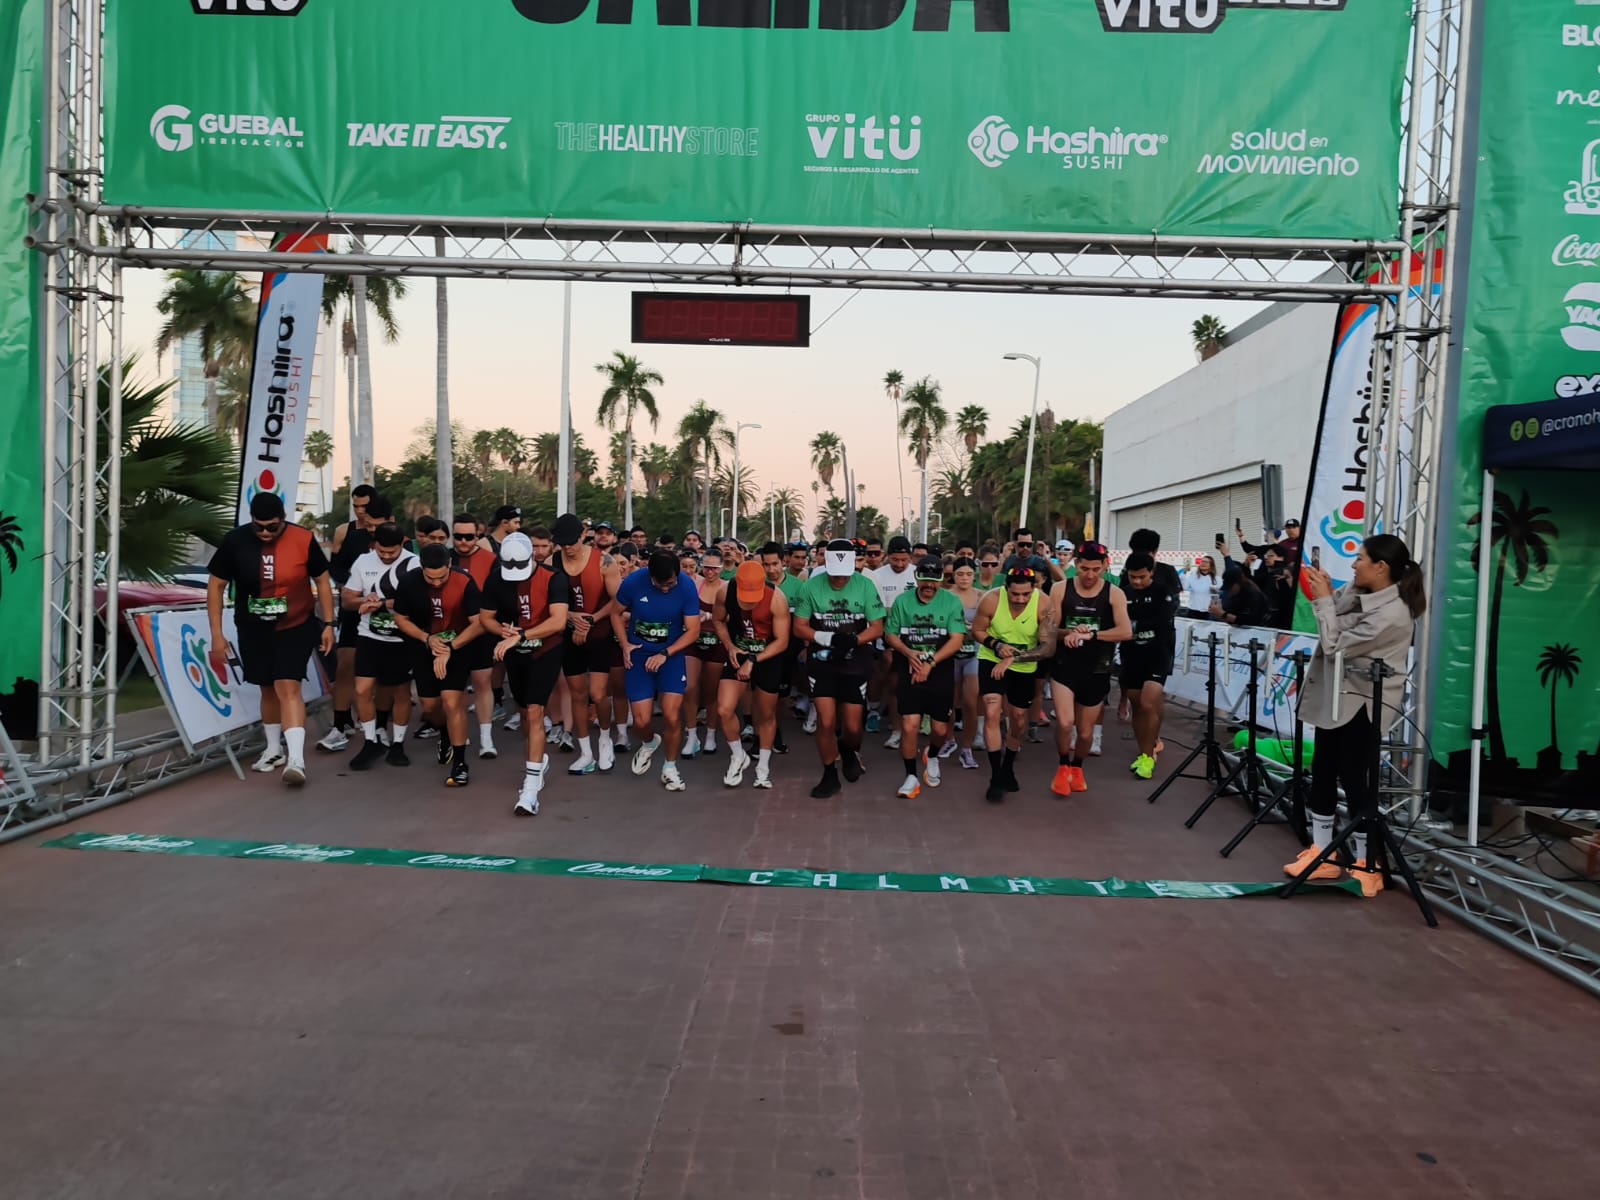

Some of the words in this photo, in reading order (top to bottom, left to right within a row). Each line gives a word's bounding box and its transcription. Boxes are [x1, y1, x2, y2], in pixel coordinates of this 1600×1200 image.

[199, 113, 304, 137] GUEBAL
[805, 114, 841, 123] GRUPO
[346, 123, 410, 147] TAKE
[411, 124, 436, 148] IT
[1309, 136, 1329, 148] en
[201, 137, 304, 149] IRRIGACIÓN
[1063, 155, 1123, 170] SUSHI
[286, 356, 303, 423] SUSHI
[263, 565, 275, 581] FIT
[649, 628, 666, 637] 012
[703, 637, 716, 645] 150
